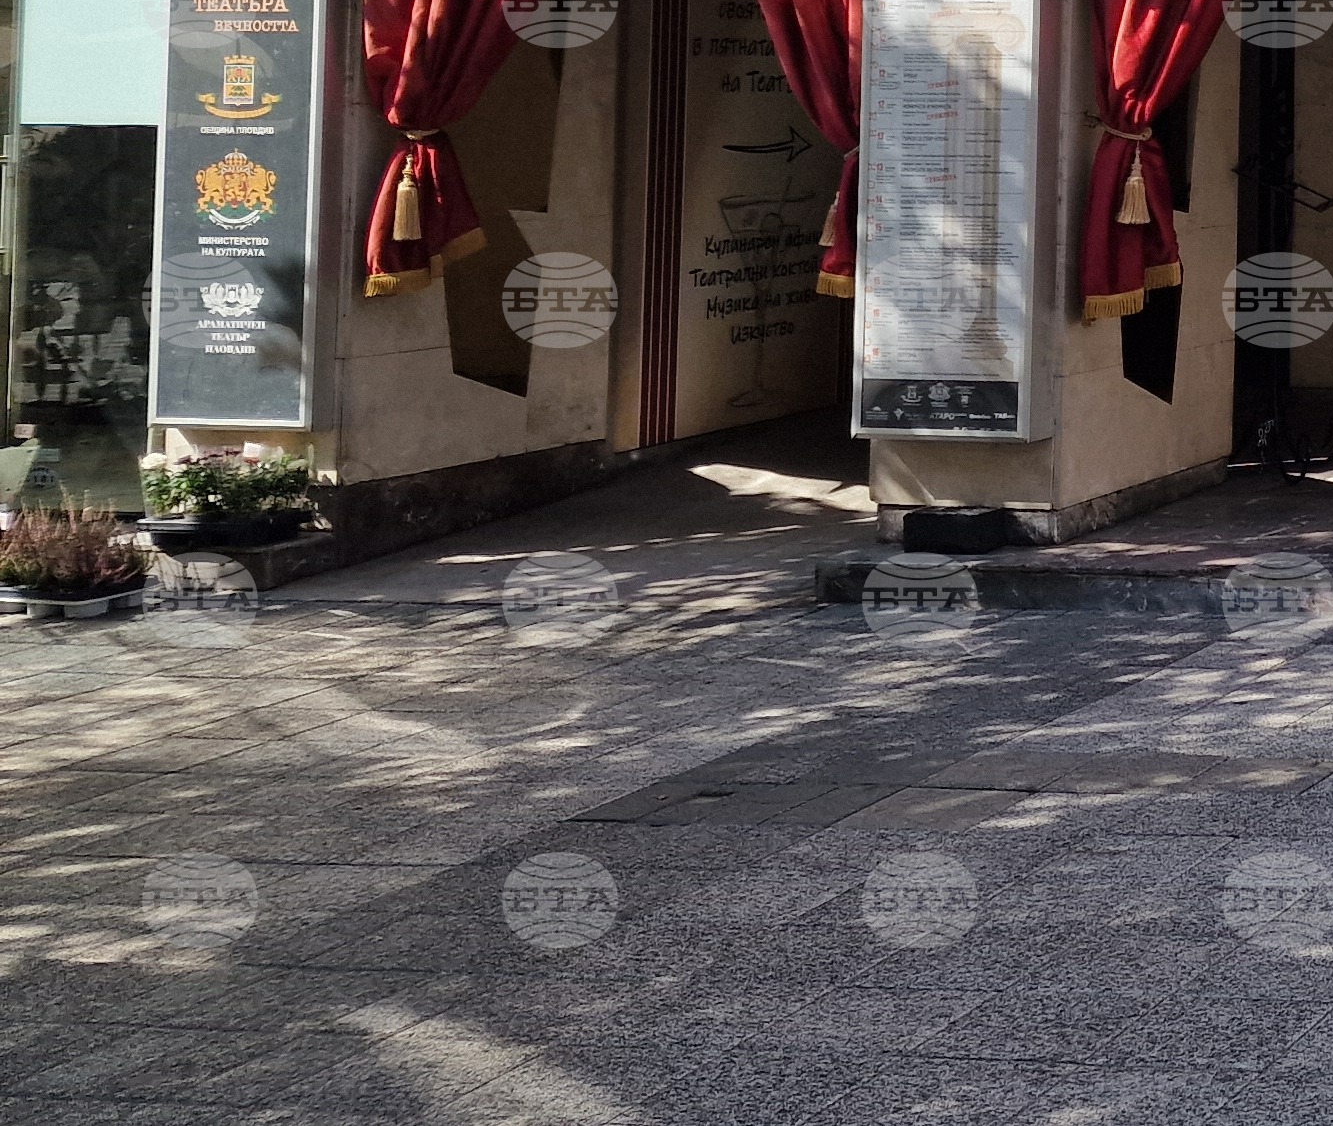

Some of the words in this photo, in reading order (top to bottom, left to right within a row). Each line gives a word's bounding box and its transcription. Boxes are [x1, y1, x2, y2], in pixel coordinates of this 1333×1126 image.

[214, 20, 299, 32] ВЕЧНОСТТА
[198, 236, 269, 246] МИНИСТЕРСТВО
[201, 248, 214, 257] НА
[215, 248, 265, 257] КУЛТУРАТА
[204, 346, 256, 355] ПЛОВДИВ
